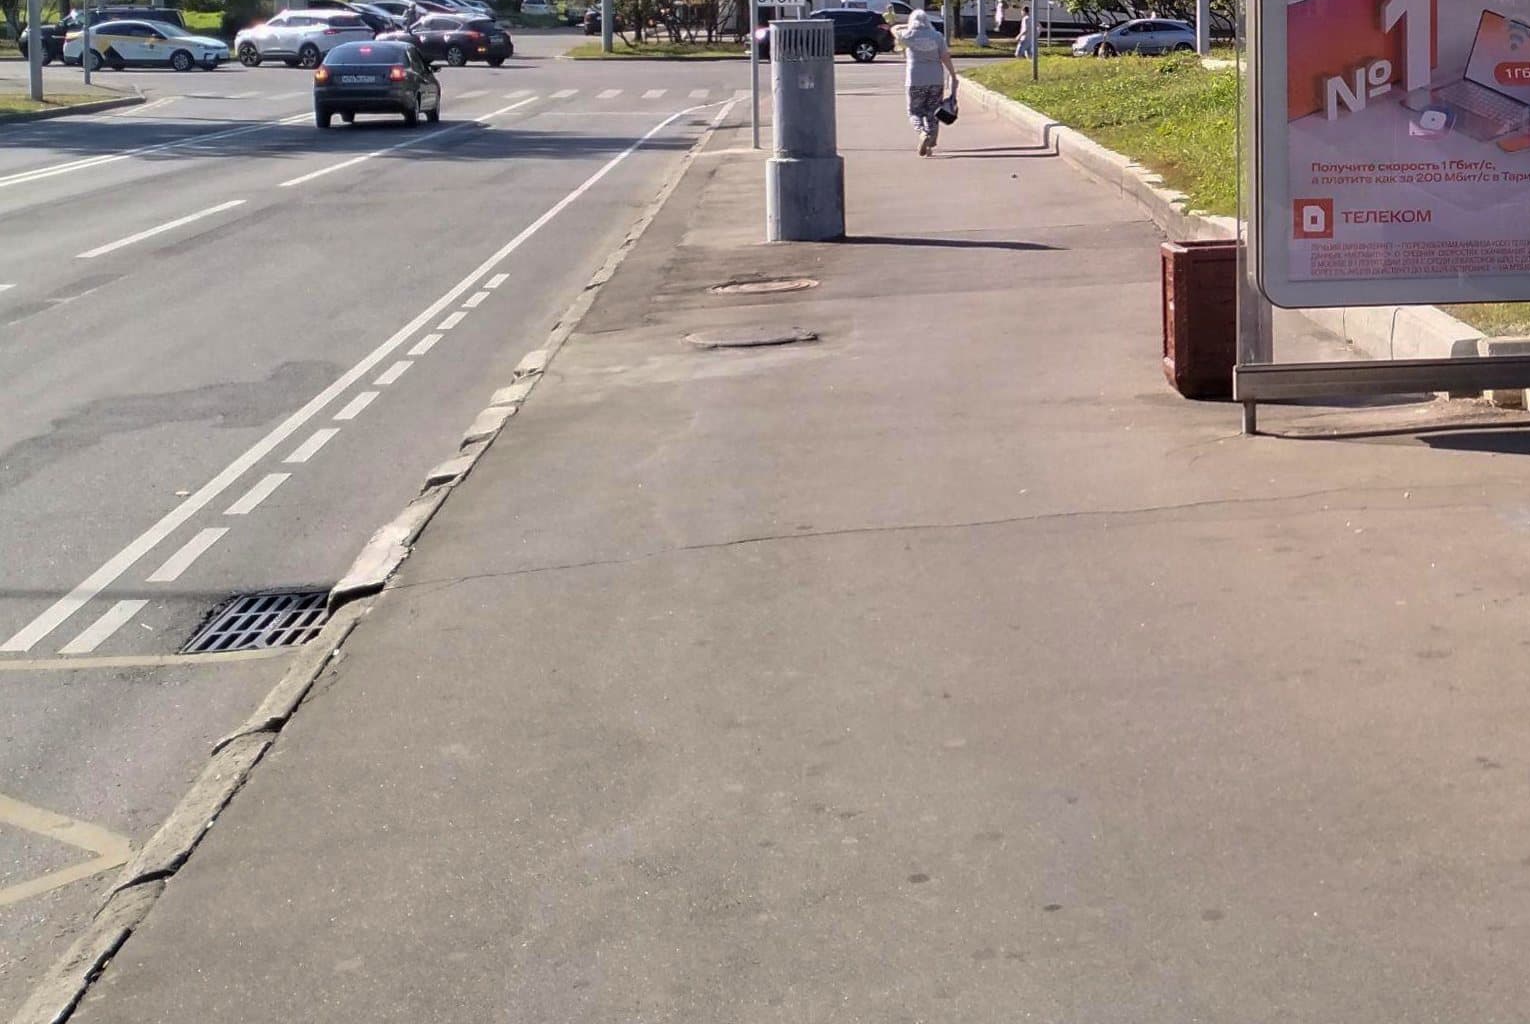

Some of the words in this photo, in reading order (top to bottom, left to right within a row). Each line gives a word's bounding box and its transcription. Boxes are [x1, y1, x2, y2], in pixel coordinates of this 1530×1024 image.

[1312, 162, 1375, 174] Получите
[1378, 163, 1440, 174] скорость
[1416, 173, 1442, 183] 200
[1341, 210, 1432, 224] ТЕЛЕКОМ
